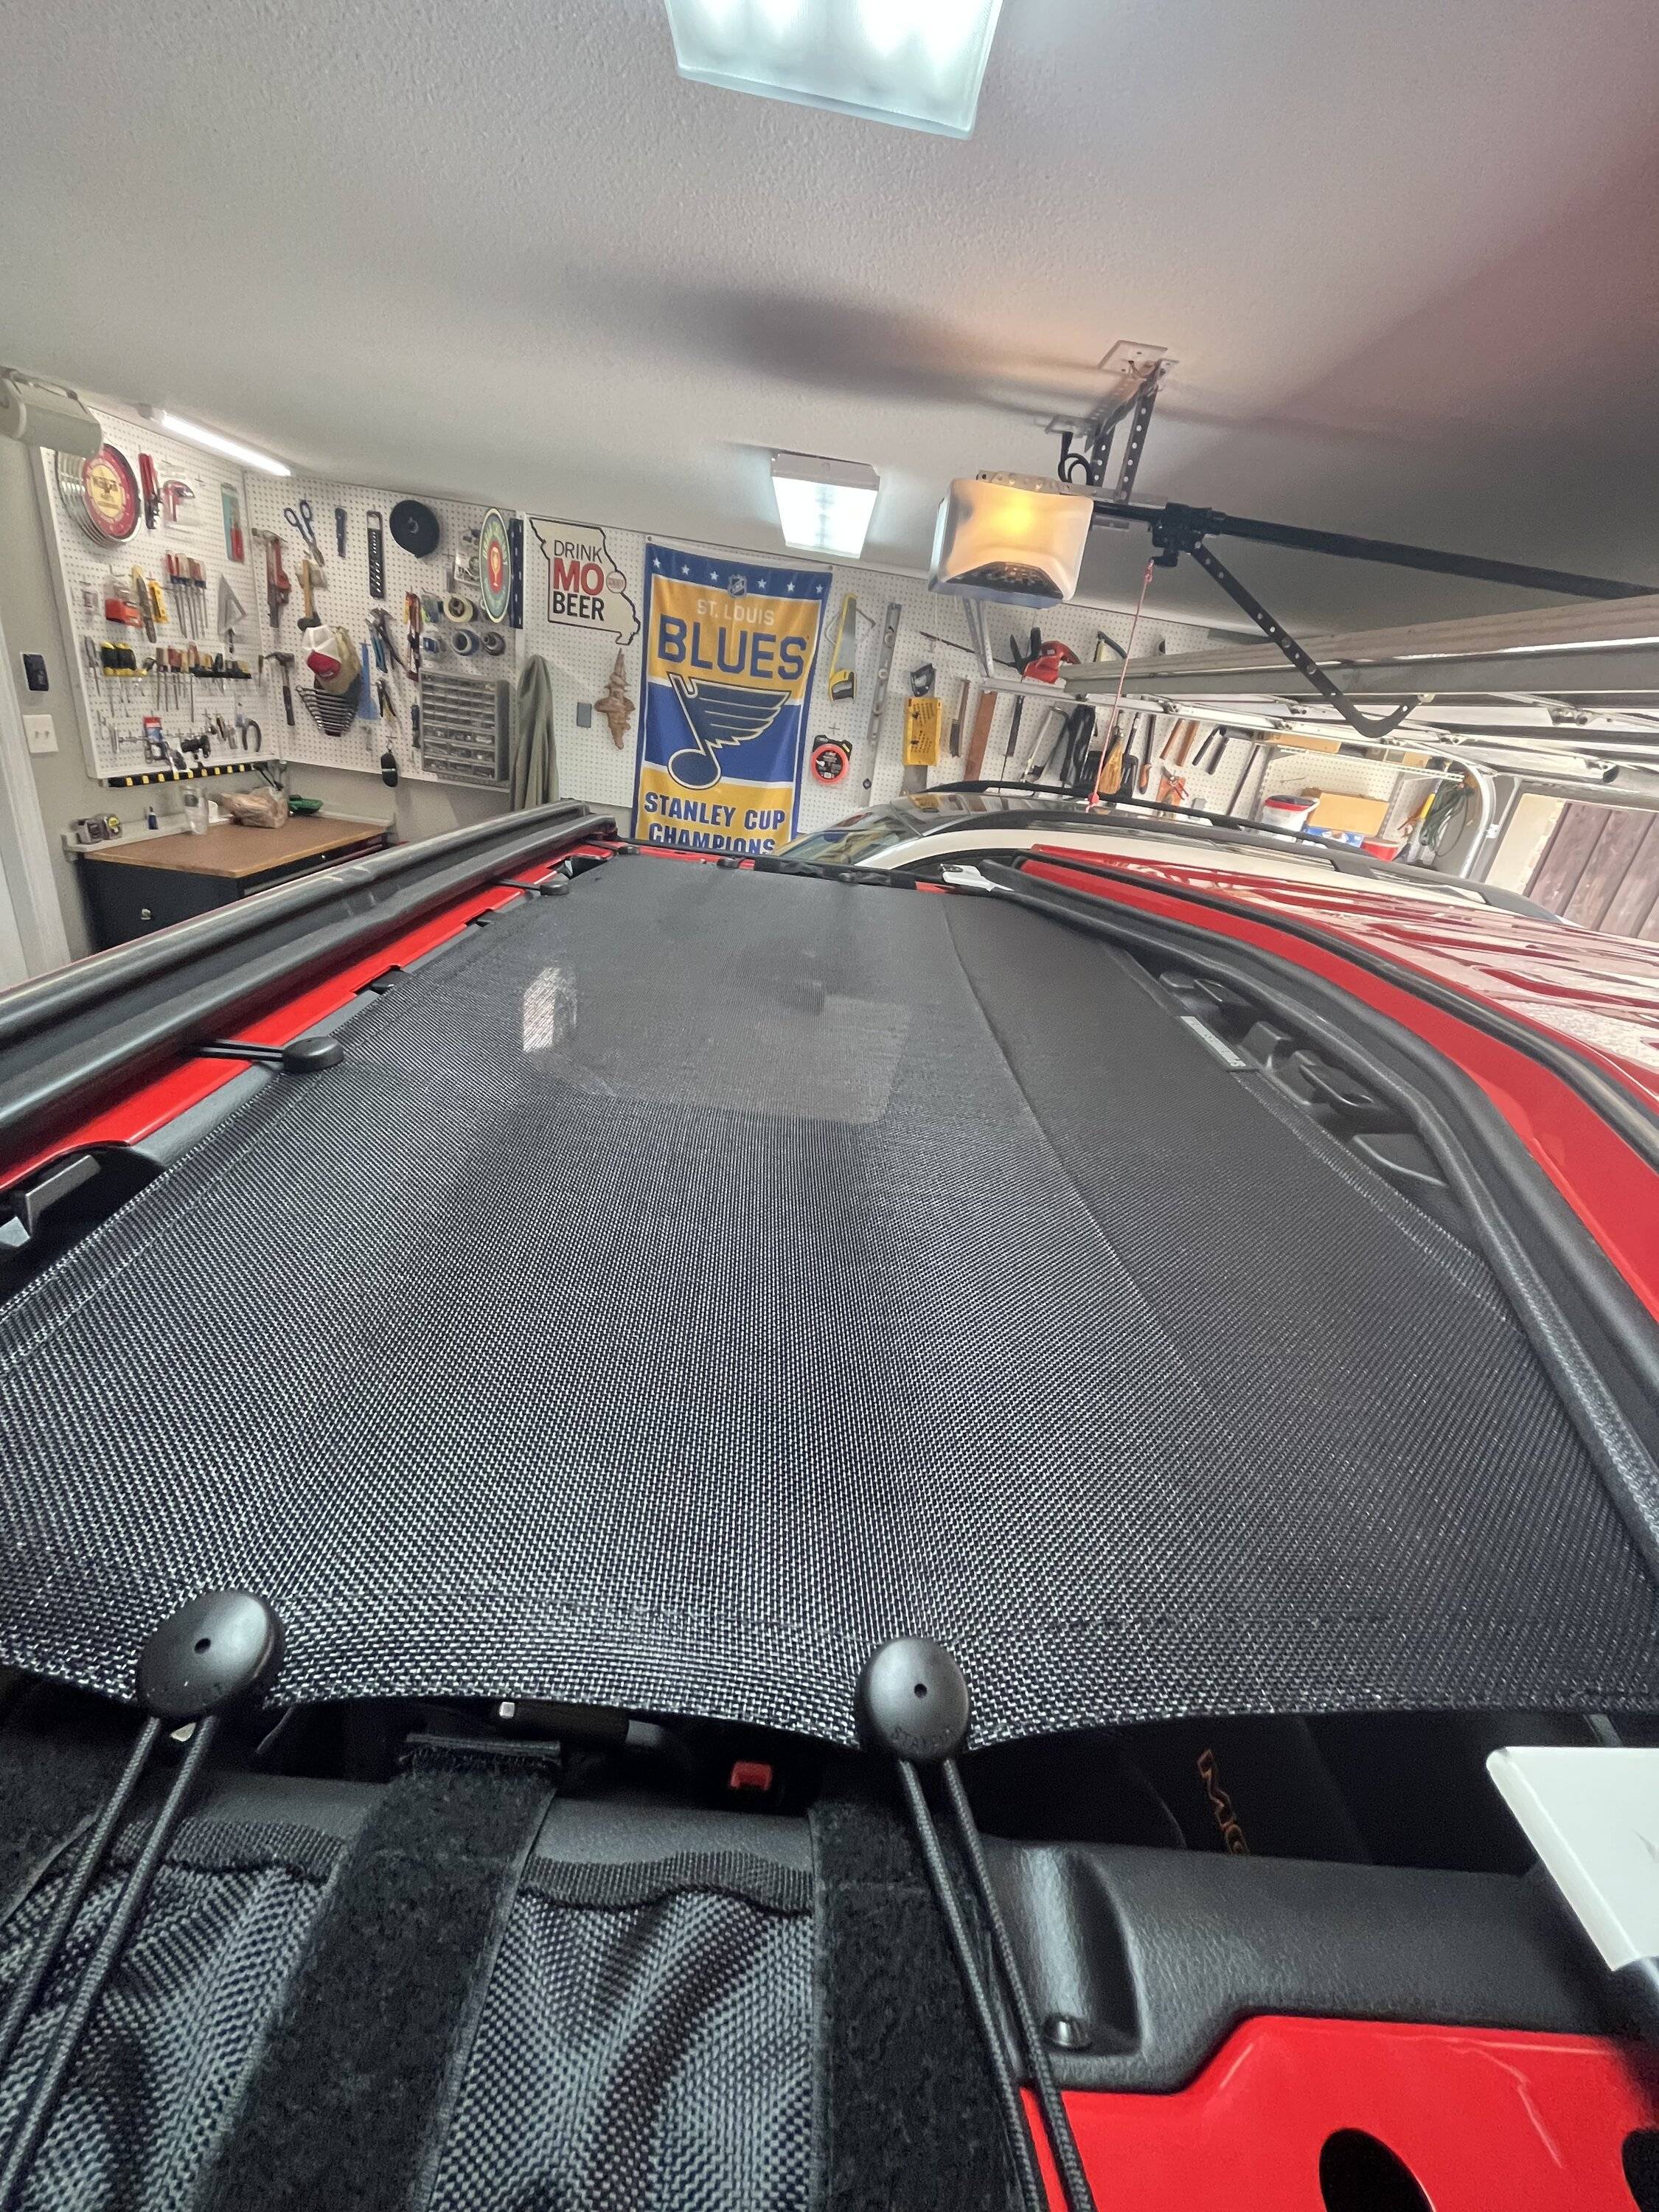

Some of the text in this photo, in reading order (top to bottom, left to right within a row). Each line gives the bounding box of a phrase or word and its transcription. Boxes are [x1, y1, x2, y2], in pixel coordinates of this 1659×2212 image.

[554, 540, 602, 563] DRINK
[553, 557, 605, 596] MO
[553, 591, 605, 622] BEER
[697, 599, 774, 625] ST. LOUIS
[658, 613, 807, 680] BLUES
[644, 791, 785, 830] STANLEY CUP
[649, 822, 776, 855] CHAMPIONS
